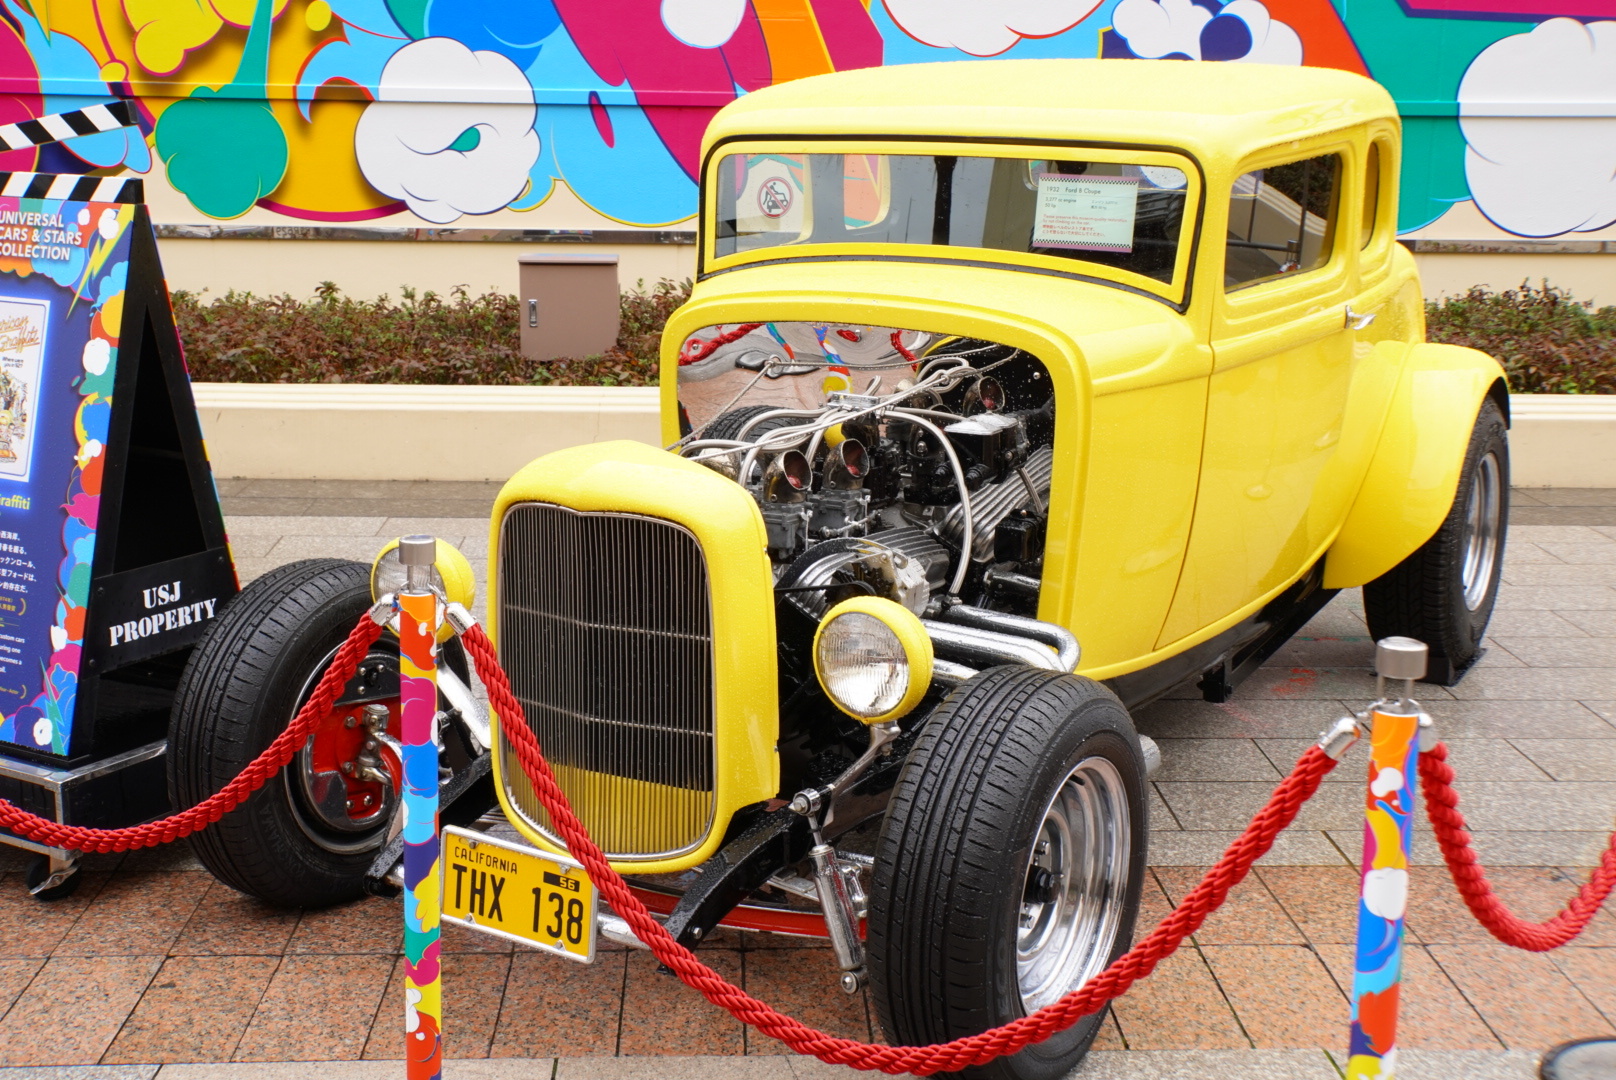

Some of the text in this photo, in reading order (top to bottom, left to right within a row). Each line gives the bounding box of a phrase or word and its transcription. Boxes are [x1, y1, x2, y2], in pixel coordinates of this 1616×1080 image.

[1084, 187, 1101, 196] Coupe
[0, 210, 65, 229] UNIVERSAL
[31, 228, 41, 243] &
[43, 229, 83, 246] STARS
[0, 494, 31, 511] raffiti
[142, 581, 181, 609] USJ
[109, 598, 216, 646] PROPERTY
[454, 845, 518, 875] CALIFORNIA
[558, 876, 576, 890] 56
[452, 863, 584, 945] THX 138
